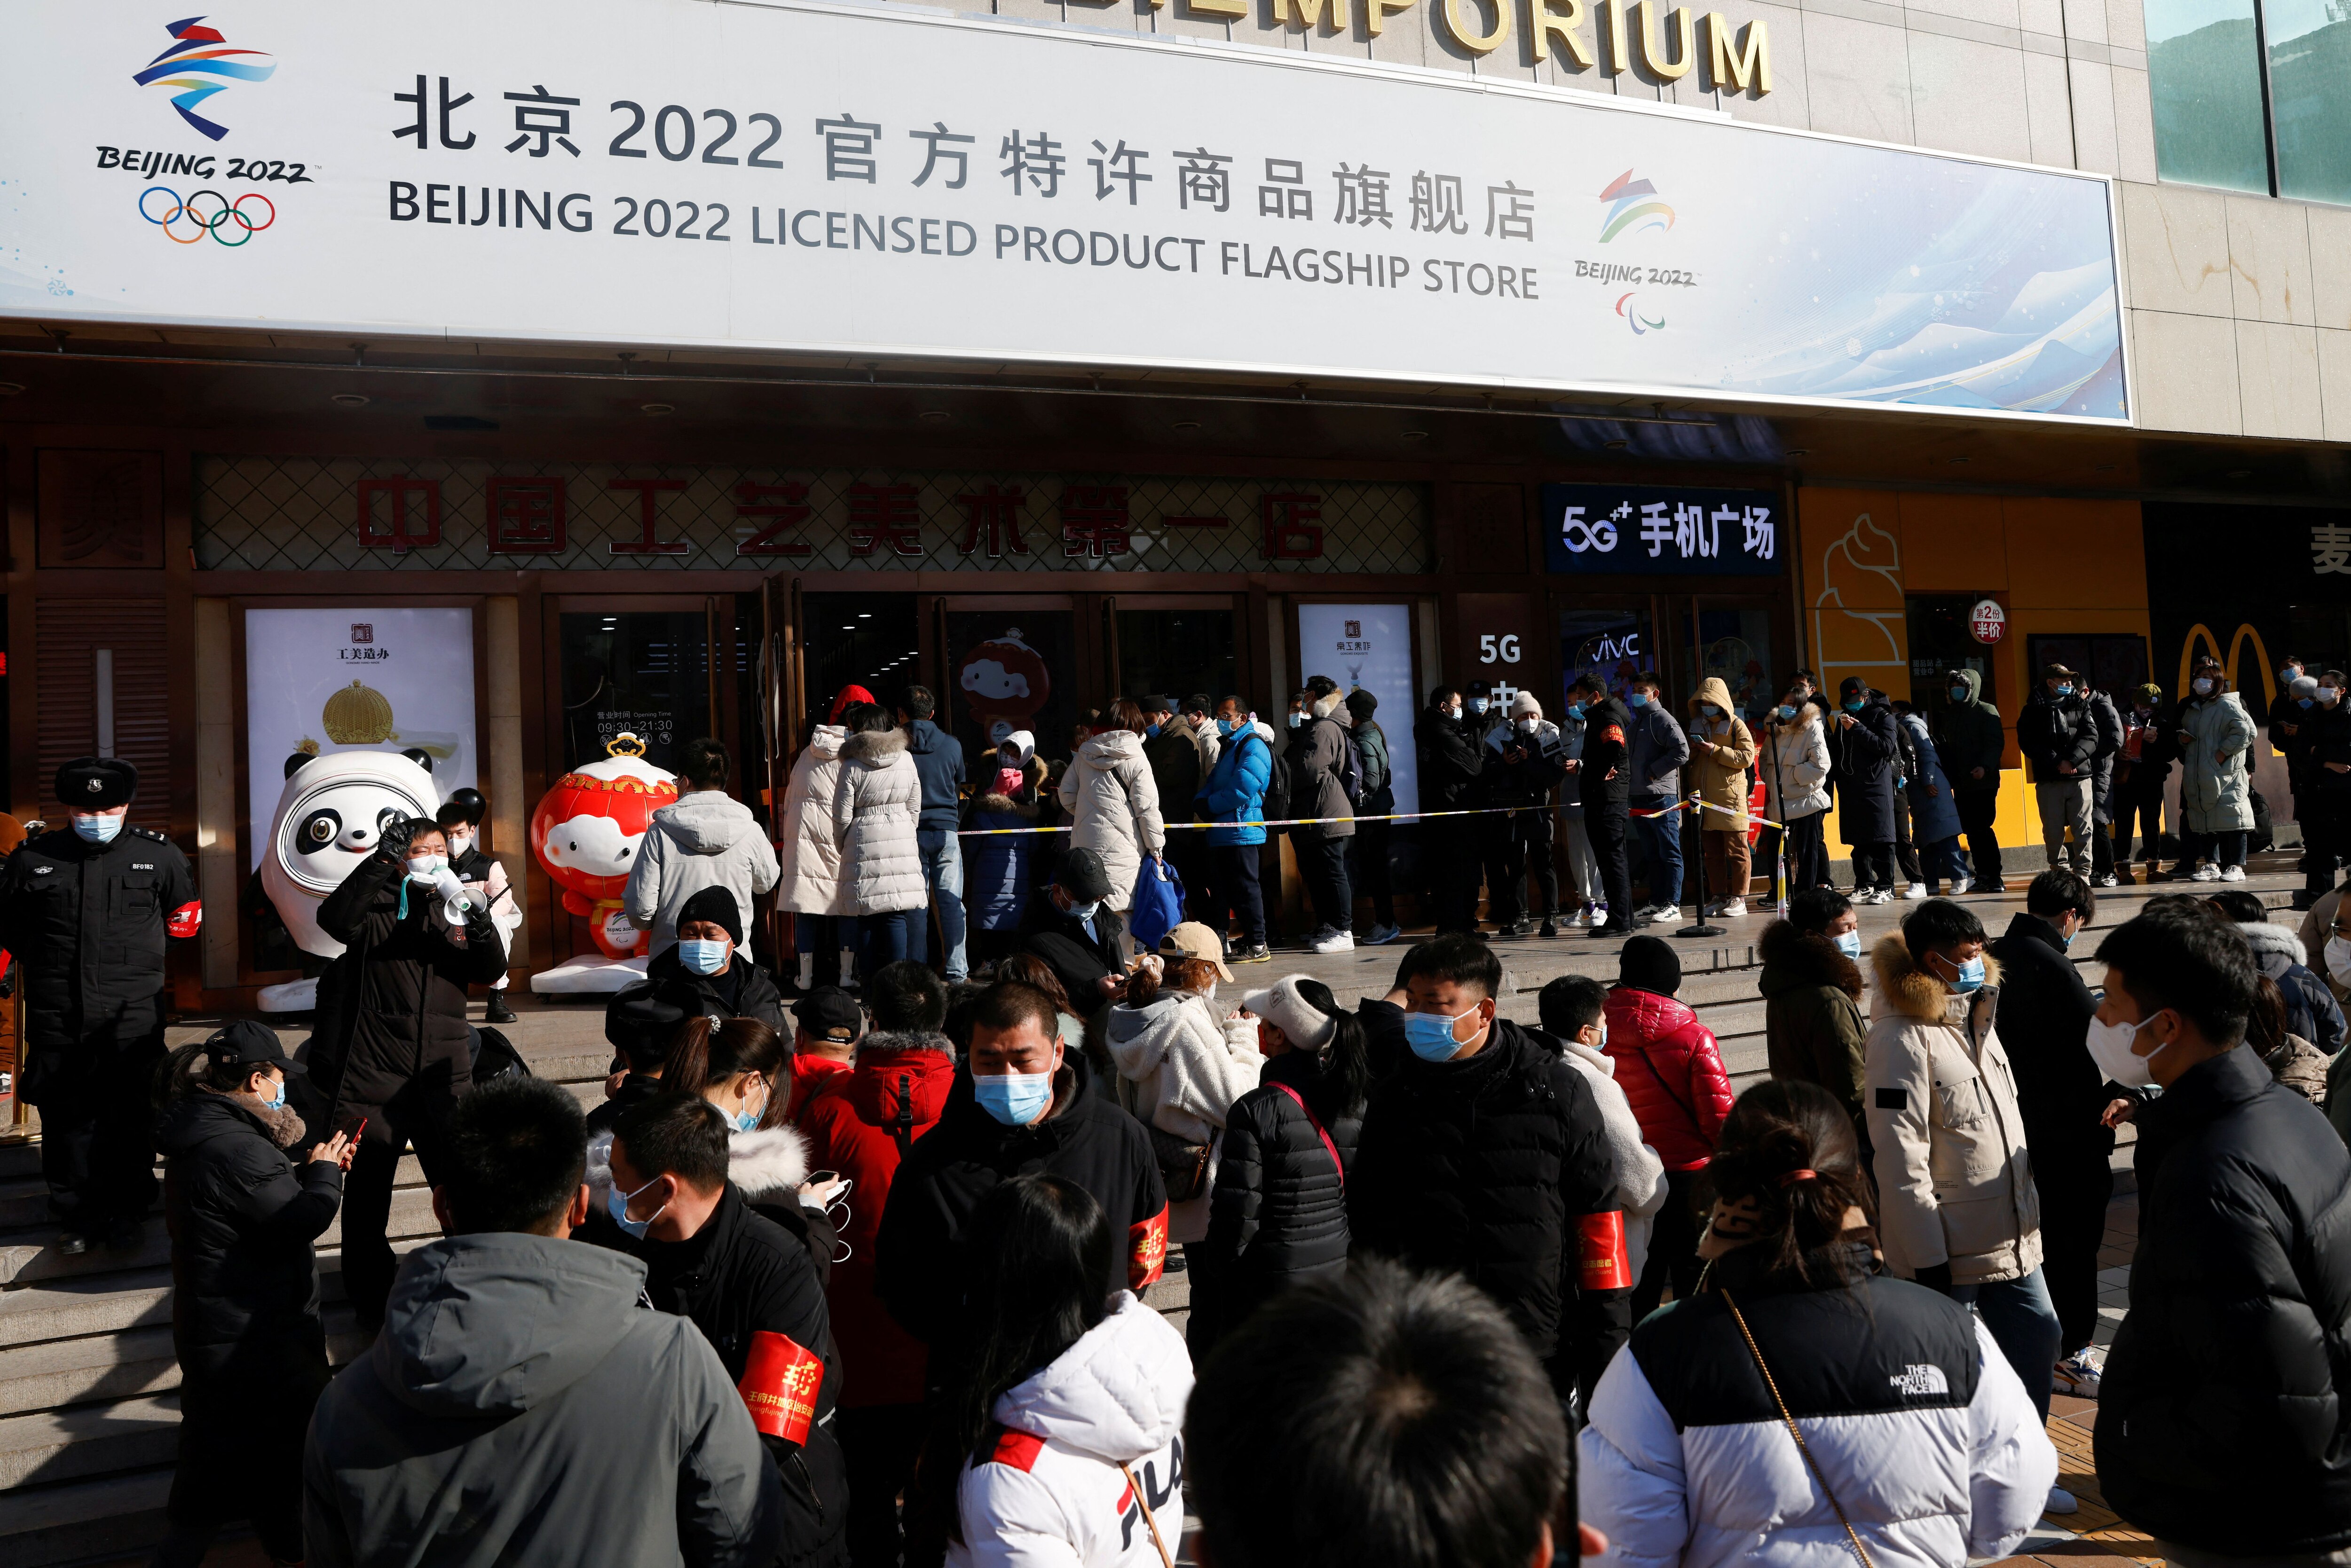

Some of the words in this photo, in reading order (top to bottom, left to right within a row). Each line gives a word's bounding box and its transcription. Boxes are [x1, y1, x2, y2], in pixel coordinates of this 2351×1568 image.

[1187, 0, 1772, 94] ORIUM
[392, 74, 581, 158] 北京
[609, 100, 783, 169] 2022
[96, 146, 216, 180] BEIJING
[226, 158, 315, 184] 2022
[390, 181, 592, 232] BEIJING
[613, 197, 731, 241] 2022
[752, 206, 977, 256] LICENSED
[995, 224, 1206, 272] PRODUCT
[1222, 241, 1410, 288] FLAGSHIP
[1423, 259, 1539, 300] STORE
[1574, 260, 1642, 285] BEIJING
[1648, 268, 1698, 288] 2022
[1640, 501, 1775, 560] 手机广场
[2311, 523, 2351, 575] 麦
[1976, 606, 2000, 619] 第2份
[1977, 622, 2001, 638] 半价
[336, 648, 389, 660] 工美造办
[1480, 634, 1521, 664] 5G
[597, 711, 631, 719] 营业时间
[1889, 1374, 1928, 1387] NORTH
[1905, 1364, 1927, 1375] THE
[1901, 1383, 1929, 1395] FACE
[747, 1404, 784, 1418] Wangfujing
